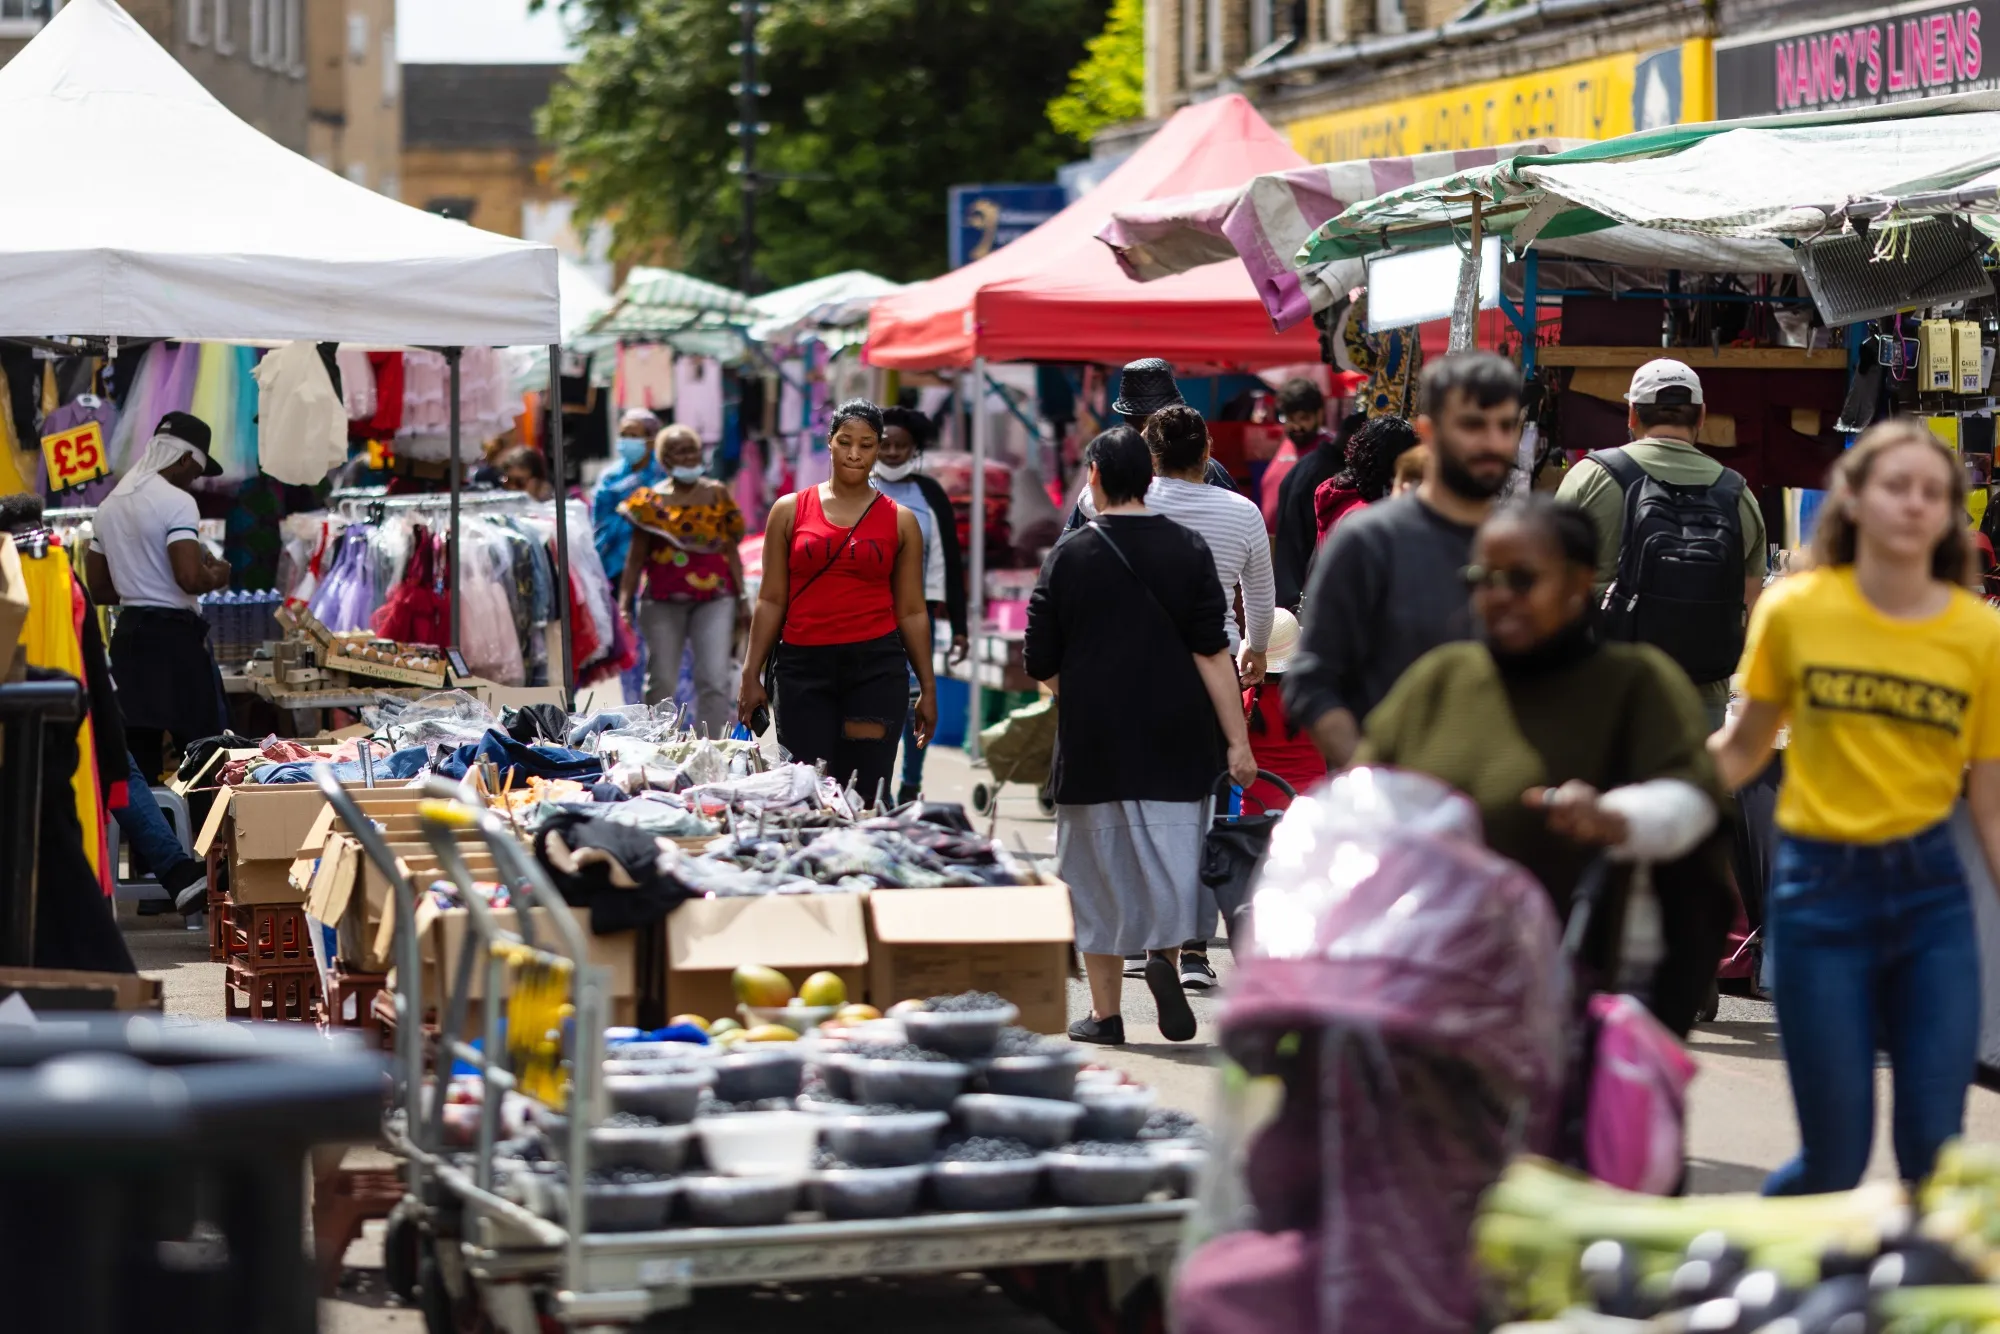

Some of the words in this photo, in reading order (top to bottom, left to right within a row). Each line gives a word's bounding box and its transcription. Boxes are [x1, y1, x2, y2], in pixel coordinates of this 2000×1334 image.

[1775, 24, 1882, 110] NANCY'S
[1886, 7, 1983, 93] LINENS
[54, 432, 98, 478] £5
